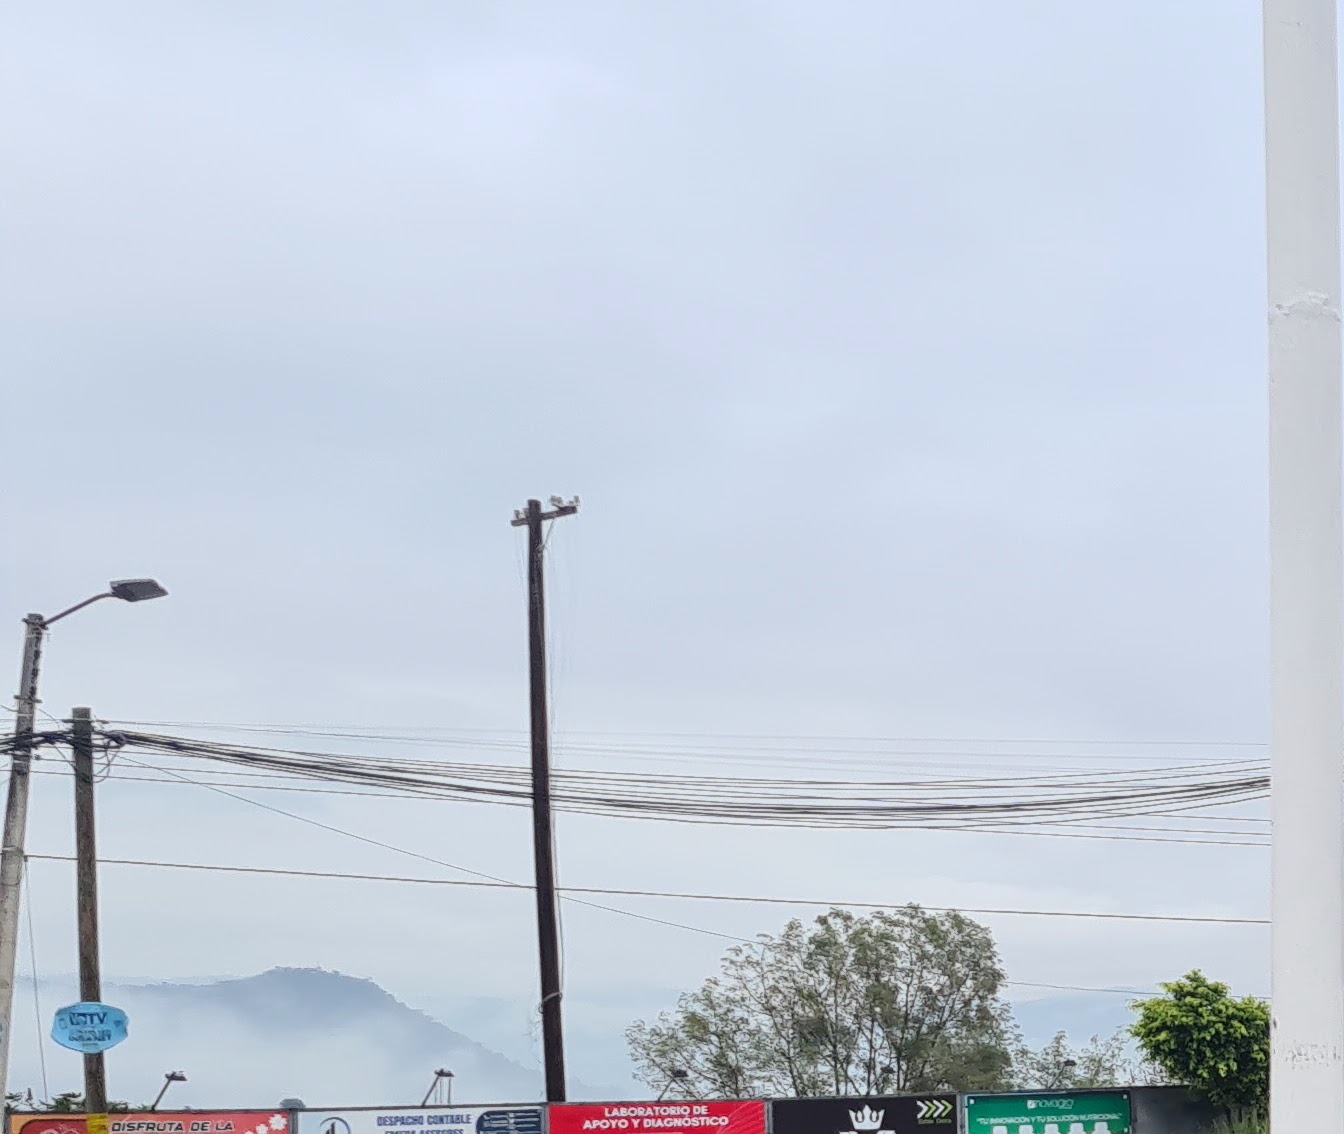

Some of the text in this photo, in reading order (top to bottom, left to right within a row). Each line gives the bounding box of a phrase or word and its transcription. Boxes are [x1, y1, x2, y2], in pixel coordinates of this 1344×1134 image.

[604, 1106, 709, 1117] LABORATORIO DE
[377, 1114, 472, 1126] DESPACHO CONTABLE
[583, 1115, 730, 1130] APOYO Y DIAGNÓSTICO
[111, 1121, 234, 1132] DISFRUTA DE LA
